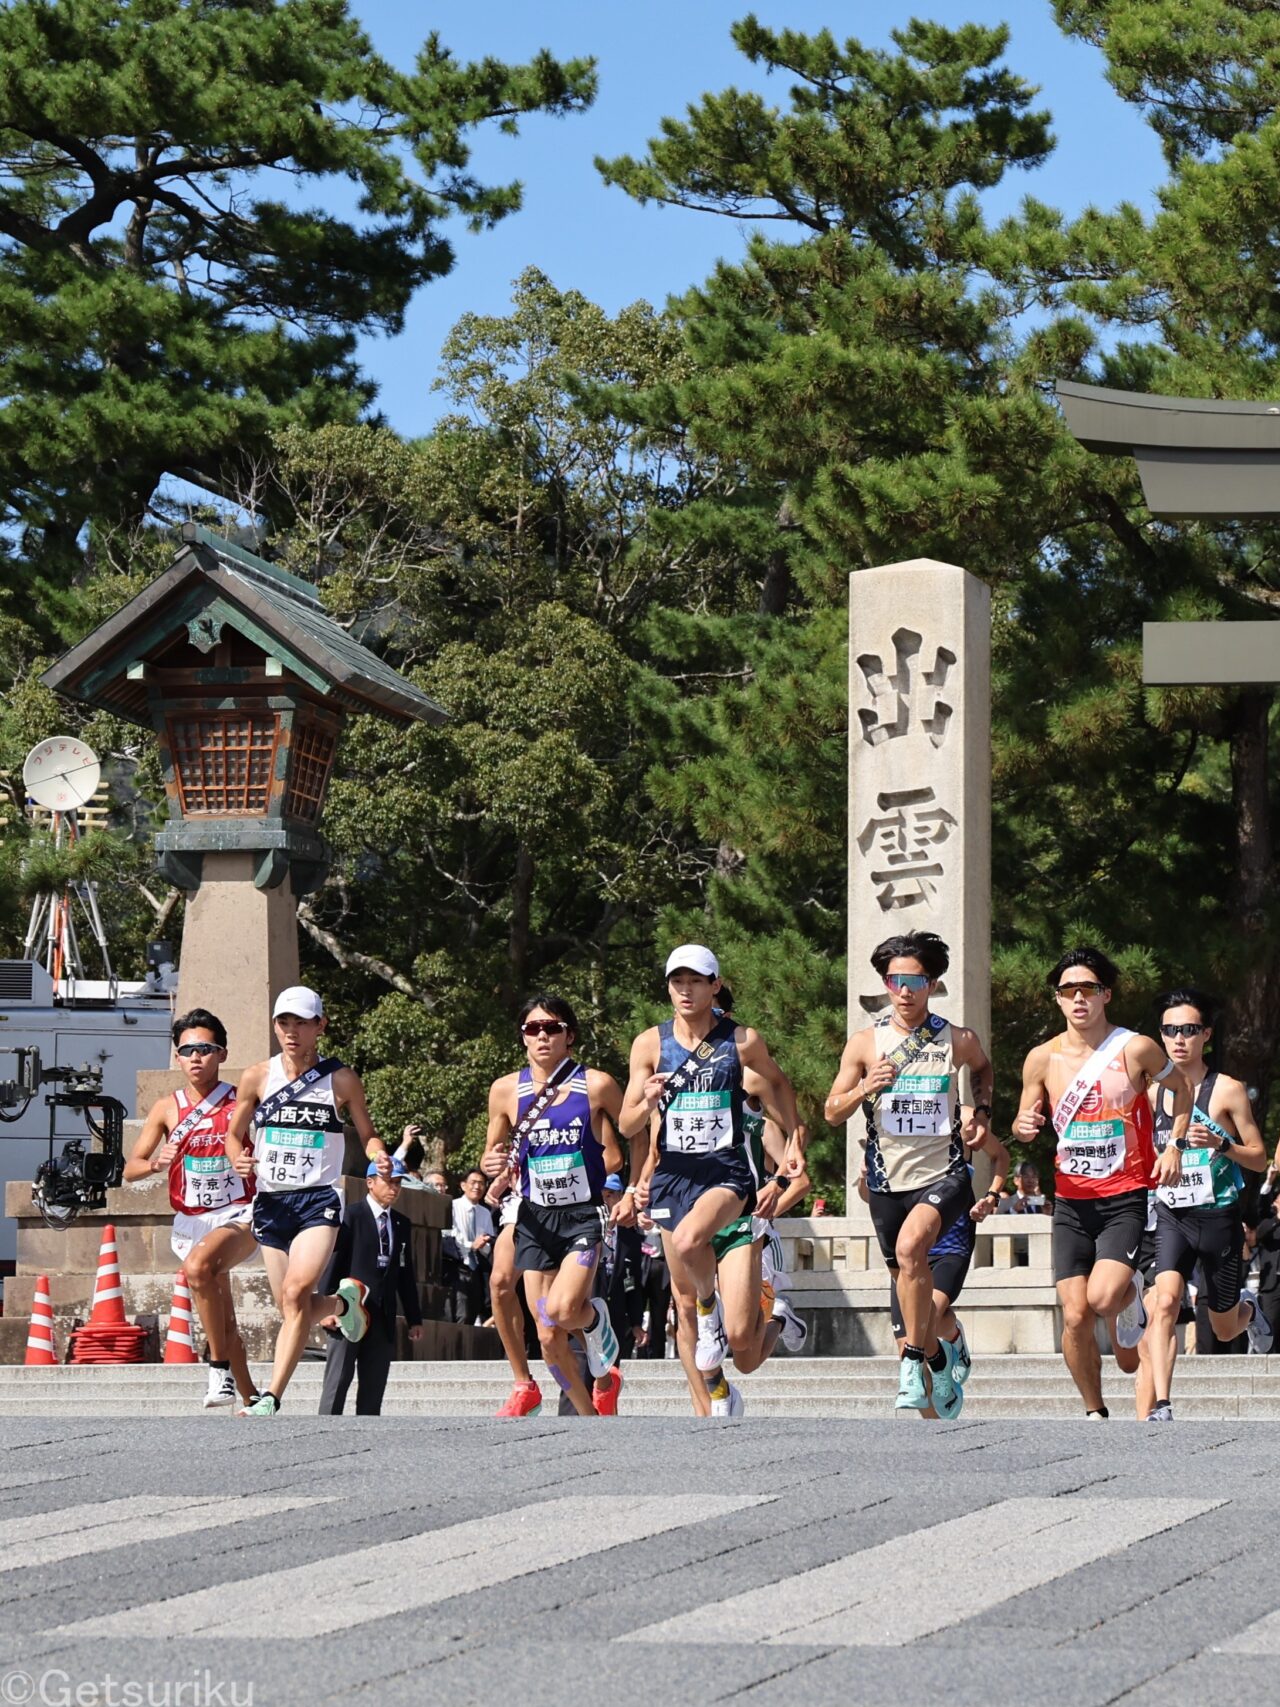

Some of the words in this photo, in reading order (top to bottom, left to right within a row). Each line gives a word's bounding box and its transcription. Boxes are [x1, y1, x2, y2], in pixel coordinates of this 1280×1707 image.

[33, 743, 92, 766] フジテレビ
[856, 626, 958, 1013] 出雲
[893, 1078, 942, 1092] 前田道路
[891, 1099, 942, 1116] 東京国際大
[171, 1108, 204, 1143] 帝京大
[672, 1115, 724, 1132] 東洋大
[896, 1117, 938, 1134] 11-1
[189, 1133, 229, 1148] 帝京大
[271, 1131, 316, 1146] 前田道路
[678, 1135, 718, 1151] 12-1
[266, 1149, 315, 1167] 関西大
[1065, 1143, 1117, 1159] 中四国選抜
[269, 1167, 306, 1183] 18-1
[1070, 1158, 1113, 1175] 22-1
[191, 1174, 235, 1191] 帝京大
[1161, 1172, 1204, 1188] 選抜
[196, 1193, 232, 1206] 13-1
[540, 1191, 577, 1208] 16-1
[1167, 1191, 1196, 1206] 3-1
